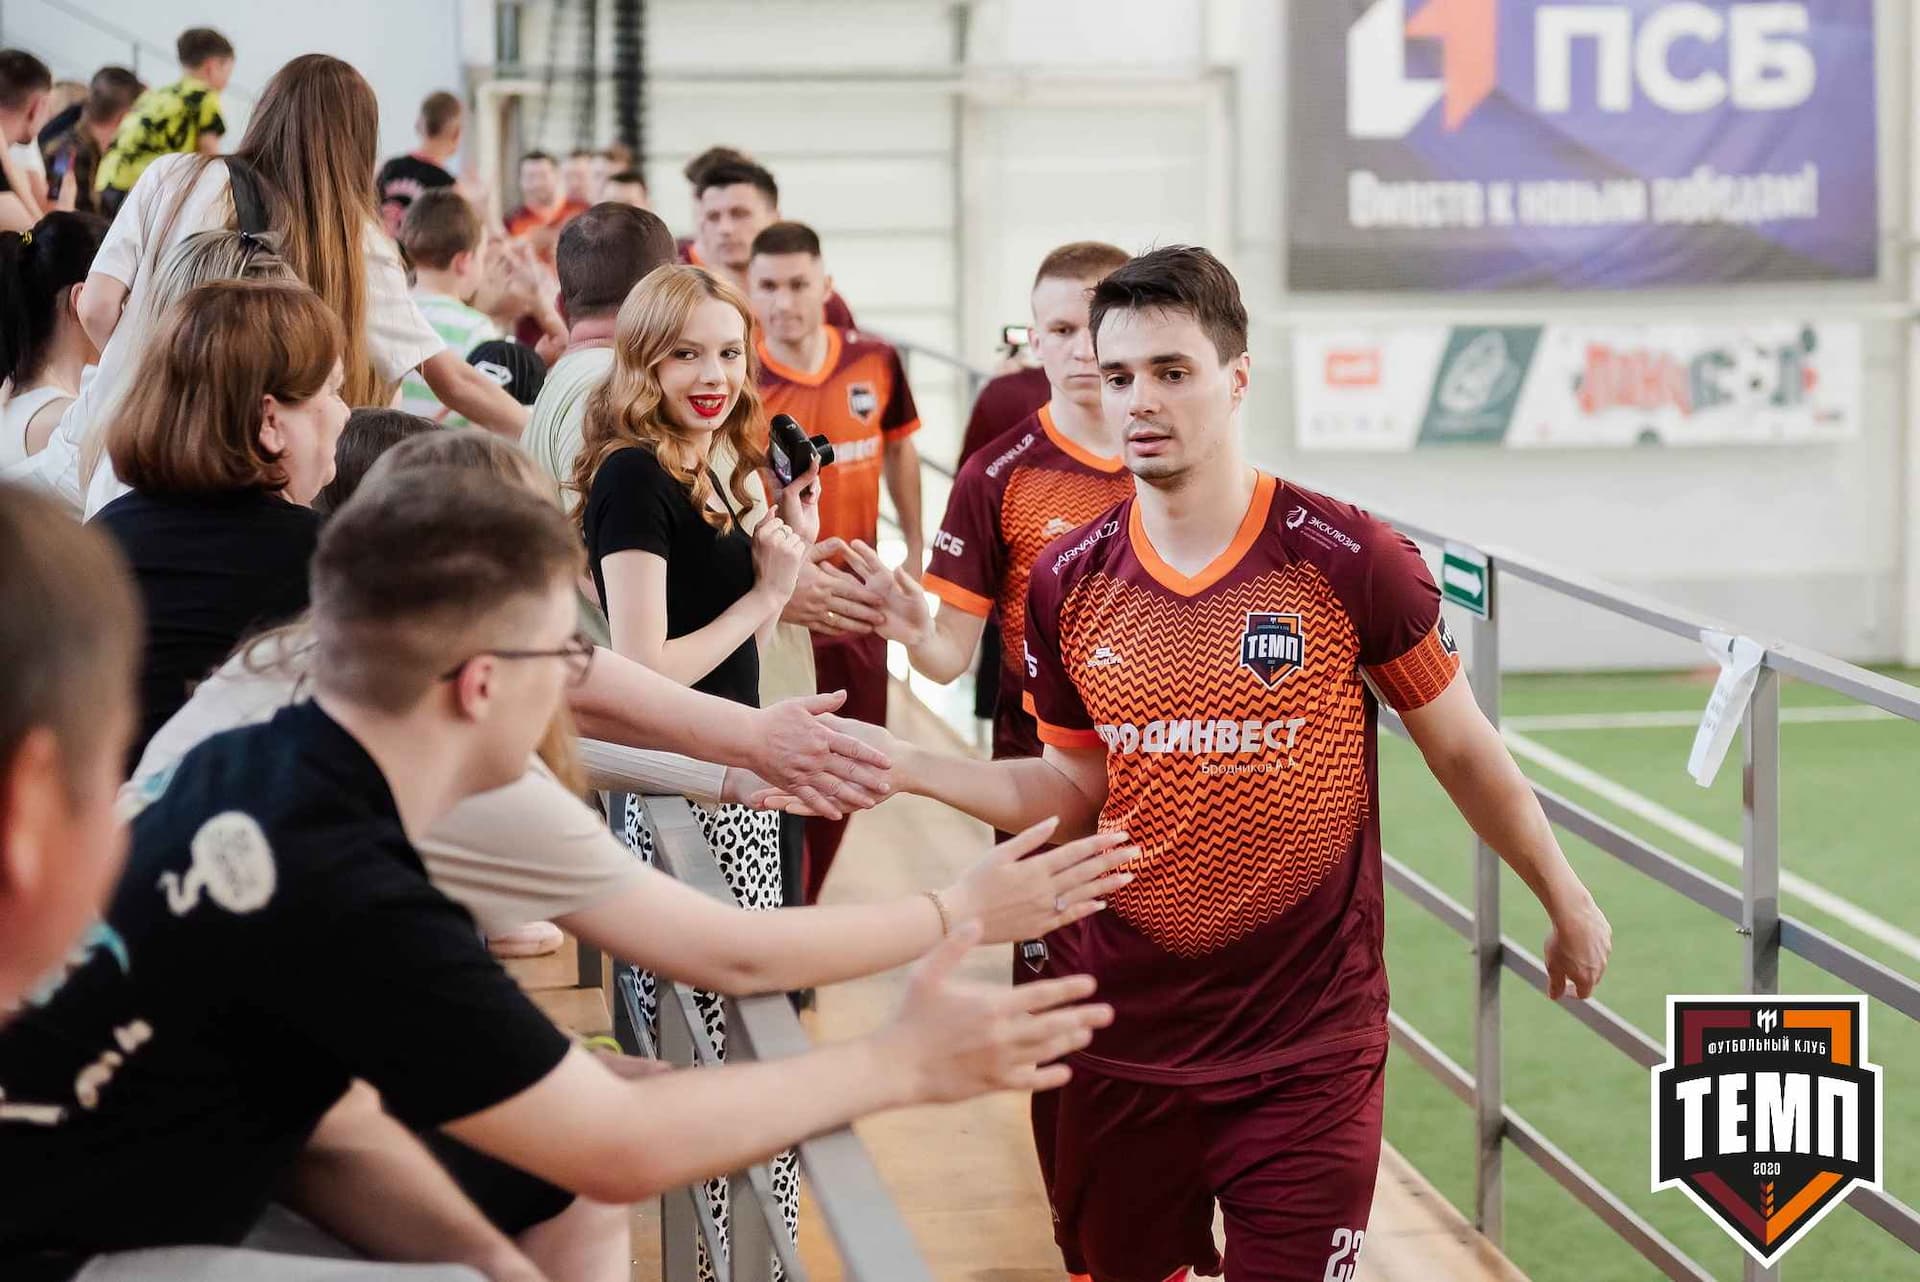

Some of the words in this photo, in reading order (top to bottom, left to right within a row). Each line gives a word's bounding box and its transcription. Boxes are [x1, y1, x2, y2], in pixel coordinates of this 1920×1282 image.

[1535, 4, 1817, 112] ПСБ
[1308, 516, 1361, 554] ЭКСКЛЮЗИВ
[1247, 633, 1299, 662] ТЕМП
[1201, 761, 1273, 777] Бродников
